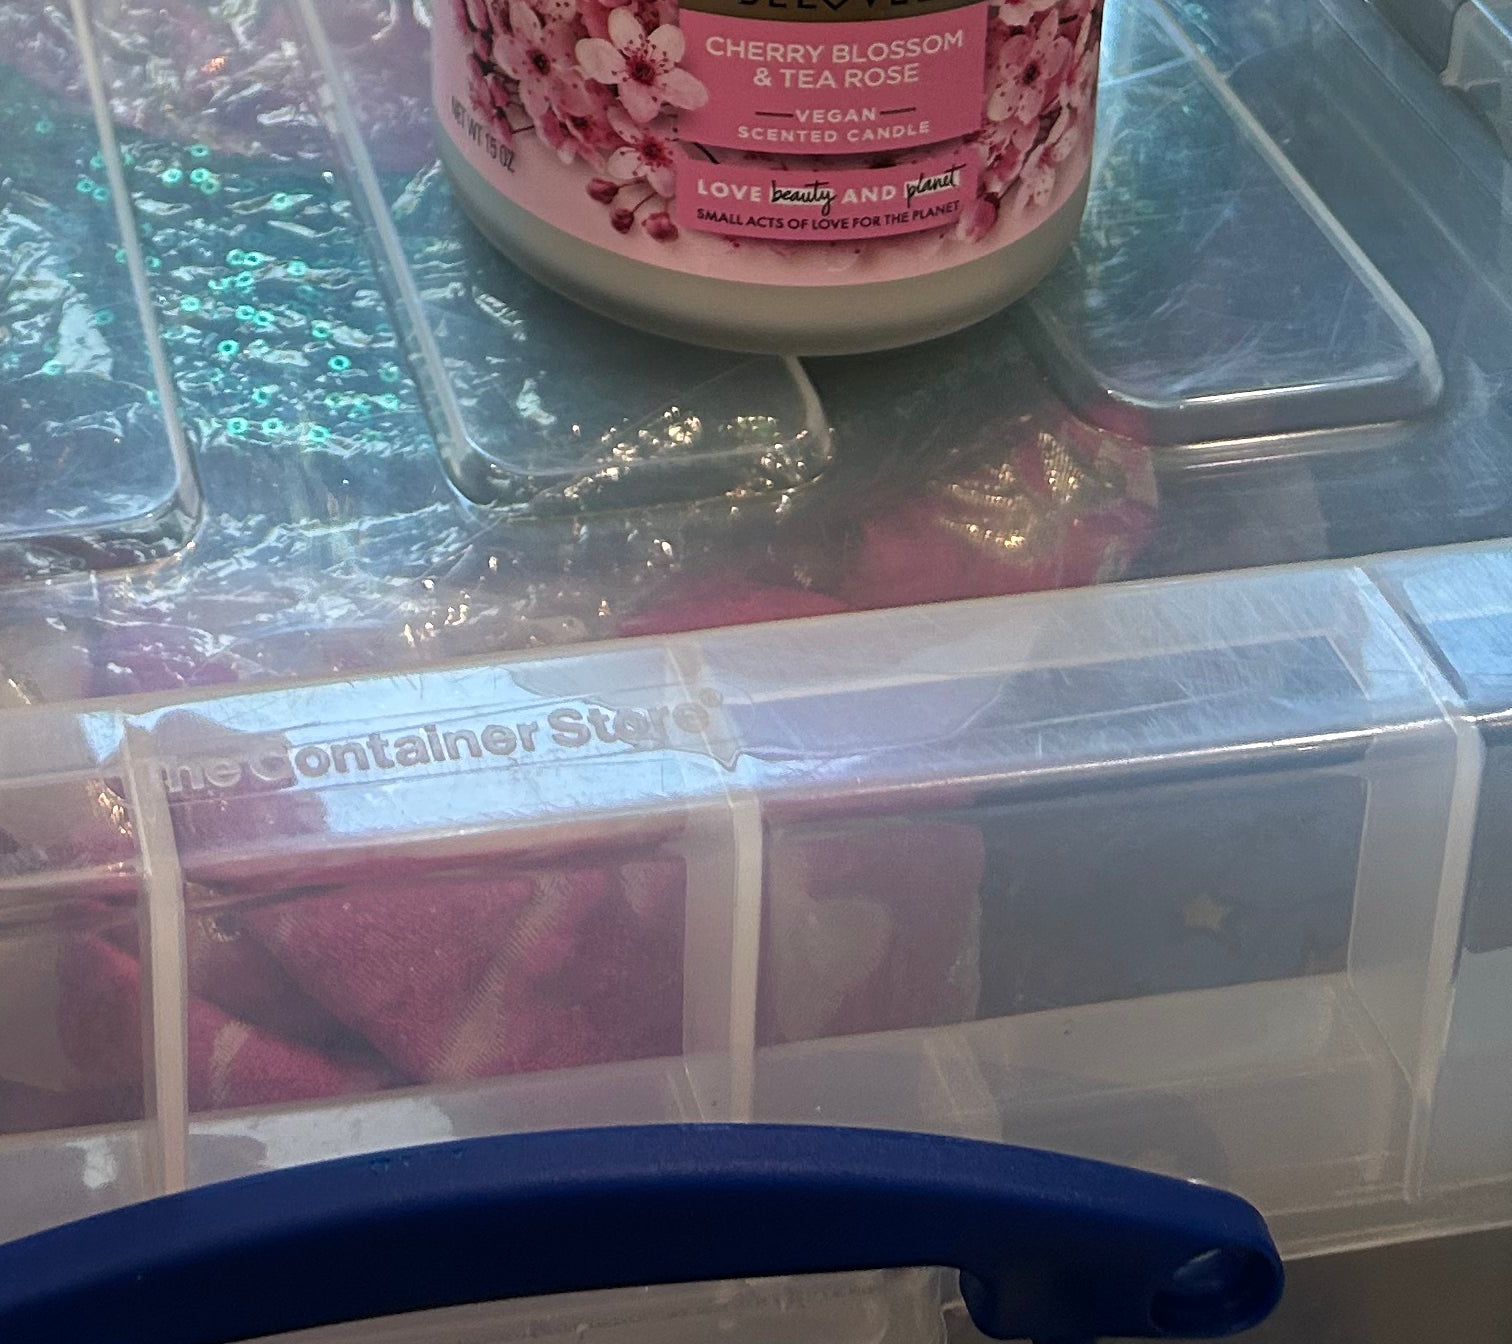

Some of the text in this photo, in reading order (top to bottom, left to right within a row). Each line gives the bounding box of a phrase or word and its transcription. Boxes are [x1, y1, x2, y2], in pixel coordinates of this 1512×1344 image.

[705, 28, 965, 64] CHERRY BLOSSOM
[752, 62, 921, 89] & TEA ROSE
[737, 120, 931, 143] SCENTED CANDLE
[794, 108, 878, 124] VEGAN
[696, 163, 968, 216] LOVE beauty AND planet
[696, 198, 961, 230] SMALL ACTS OF LOVE FOR THE PLANET
[248, 722, 538, 782] Container
